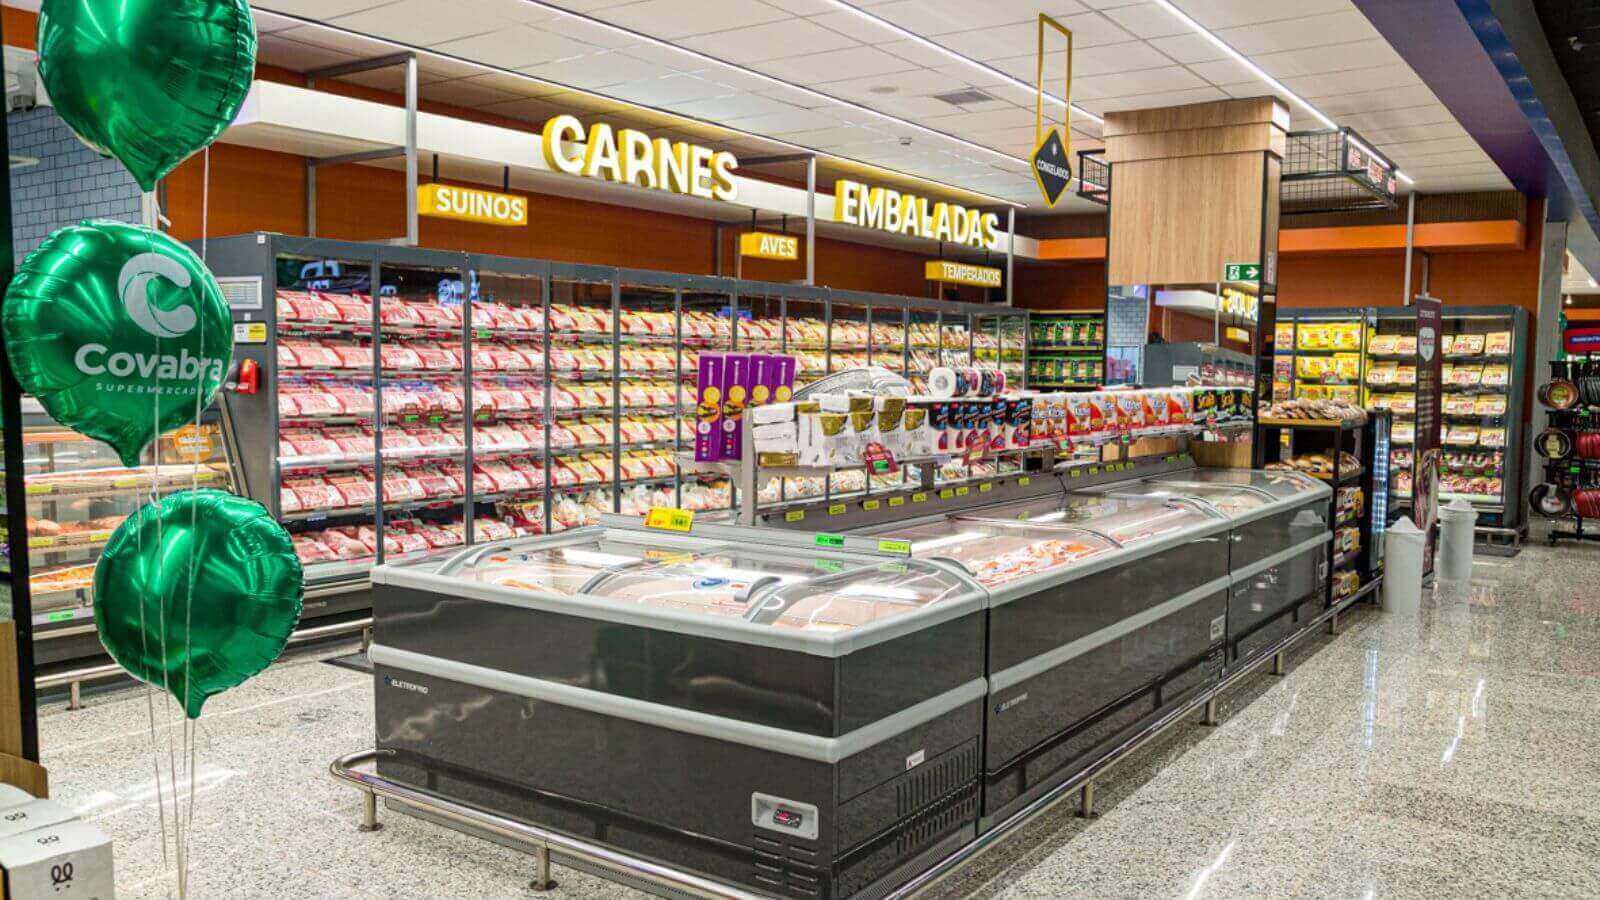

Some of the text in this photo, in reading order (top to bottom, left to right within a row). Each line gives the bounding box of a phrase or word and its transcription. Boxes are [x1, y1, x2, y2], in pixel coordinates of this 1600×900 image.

[543, 114, 738, 200] CARNES
[435, 187, 524, 221] SUINOS
[834, 179, 1000, 249] EMBALADAS
[759, 235, 795, 257] AVES
[943, 263, 1001, 286] TEMPERADOS
[74, 342, 223, 382] Covabra
[96, 382, 208, 397] SUPERMERCAD
